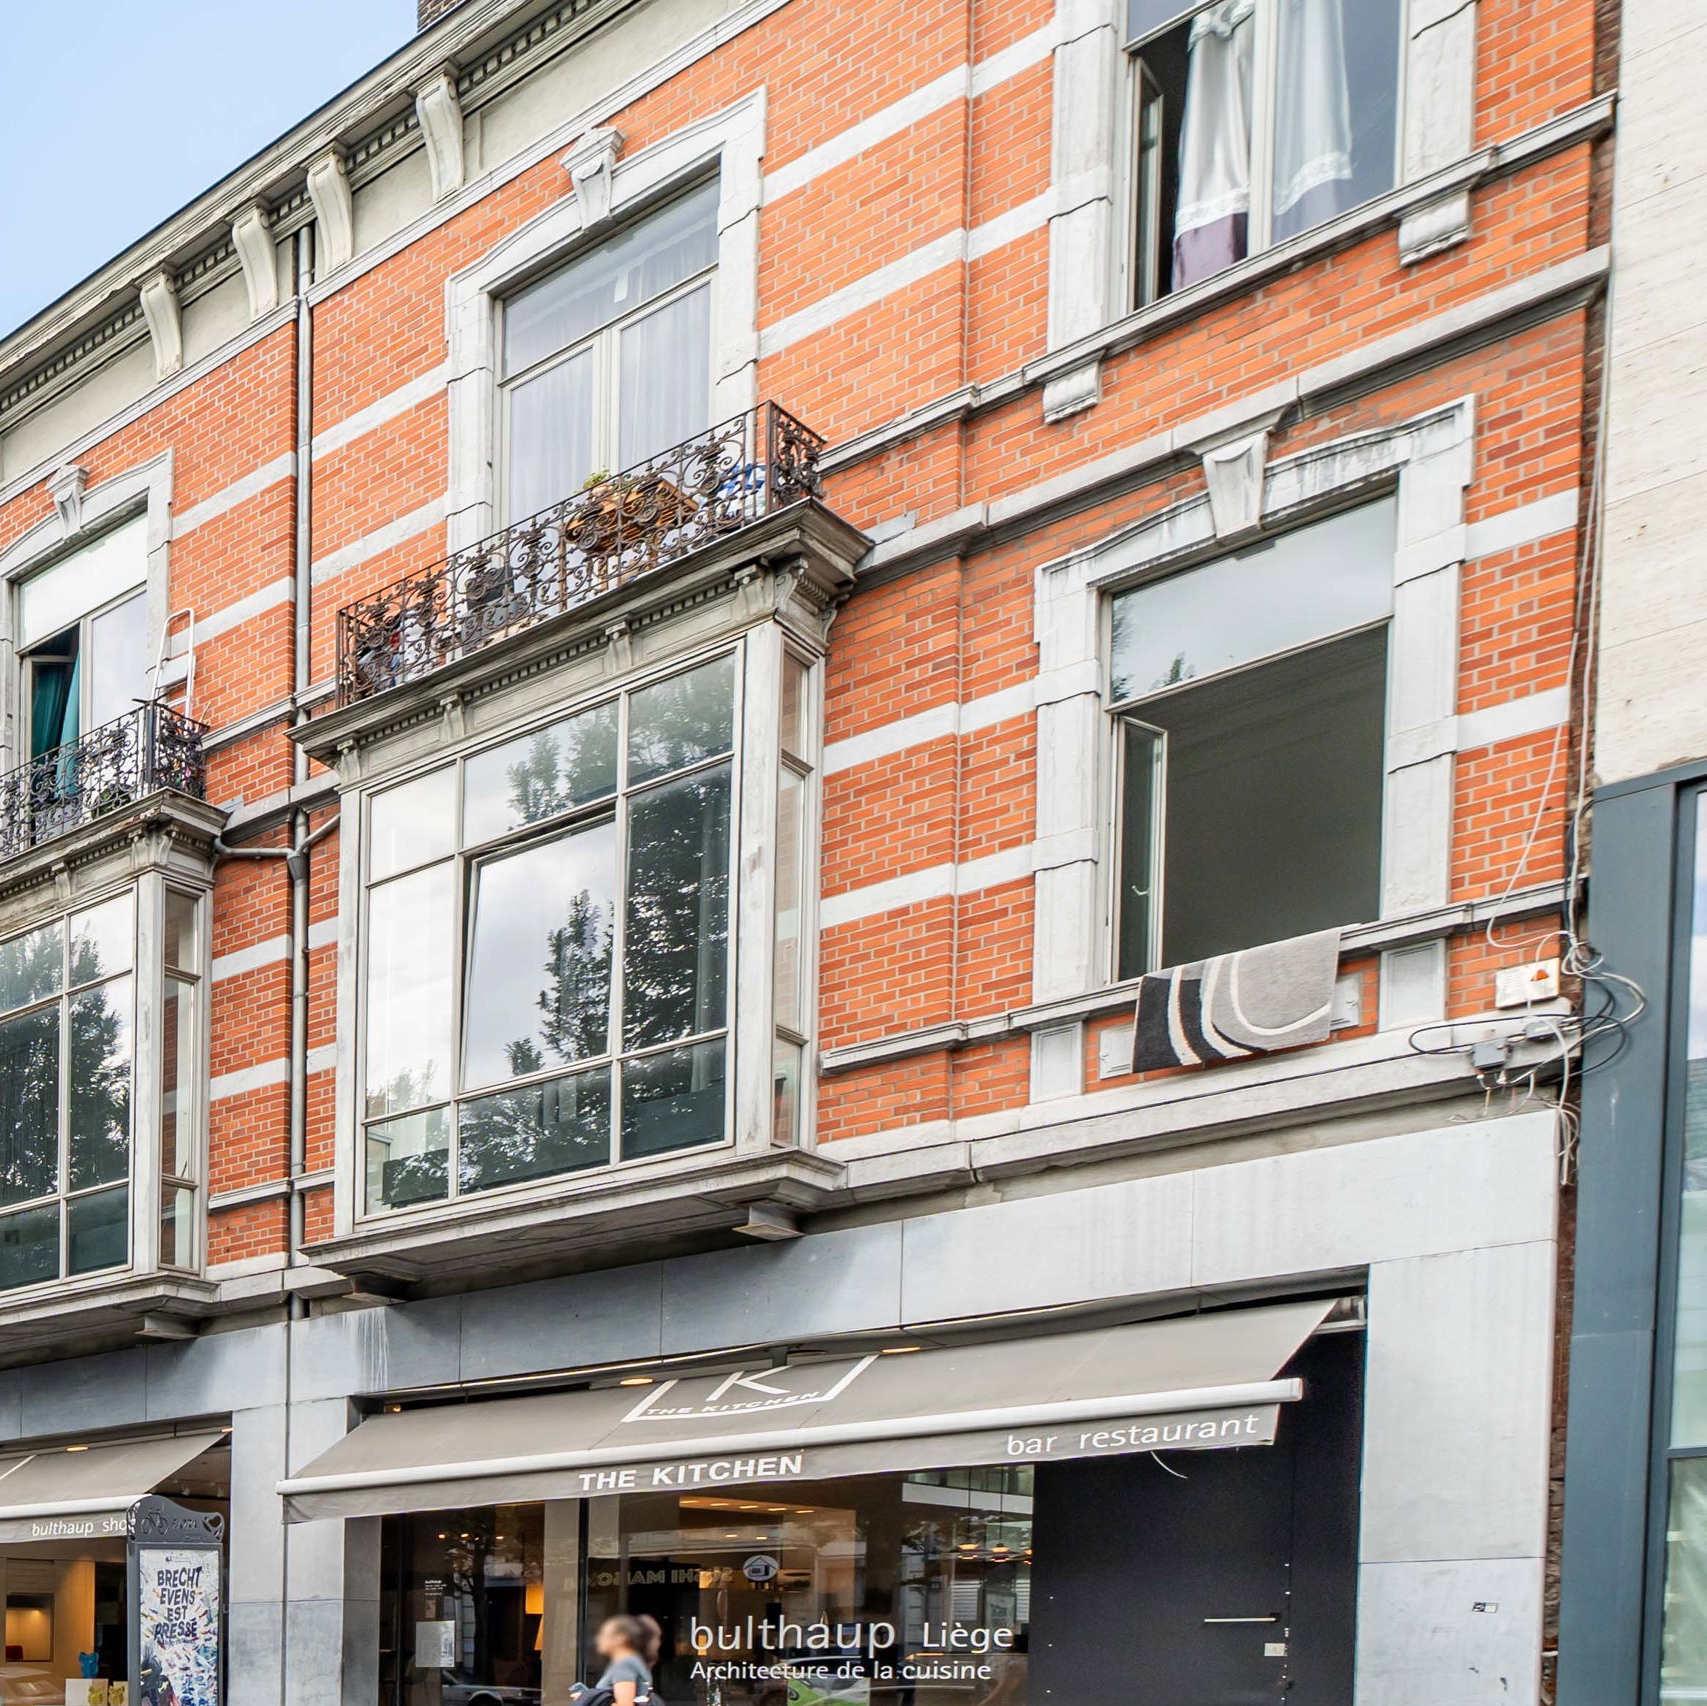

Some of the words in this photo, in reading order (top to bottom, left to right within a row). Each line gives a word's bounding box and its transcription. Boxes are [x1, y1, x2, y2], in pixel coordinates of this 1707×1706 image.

[646, 1405, 693, 1416] THE
[701, 1391, 820, 1414] KITCHEN
[1007, 1434, 1058, 1456] bar
[1079, 1414, 1259, 1450] restaurant
[579, 1469, 637, 1492] THE
[652, 1454, 804, 1486] KITCHEN
[32, 1520, 94, 1538] bulthaup
[157, 1566, 203, 1588] BRECHT
[160, 1588, 196, 1606] EVENS
[167, 1606, 188, 1622] EST
[690, 1615, 896, 1659] bulthaup
[923, 1621, 1013, 1654] Liège
[690, 1661, 829, 1680] Architecture
[837, 1662, 865, 1680] de
[874, 1662, 899, 1680] la
[902, 1661, 991, 1680] cuisine
